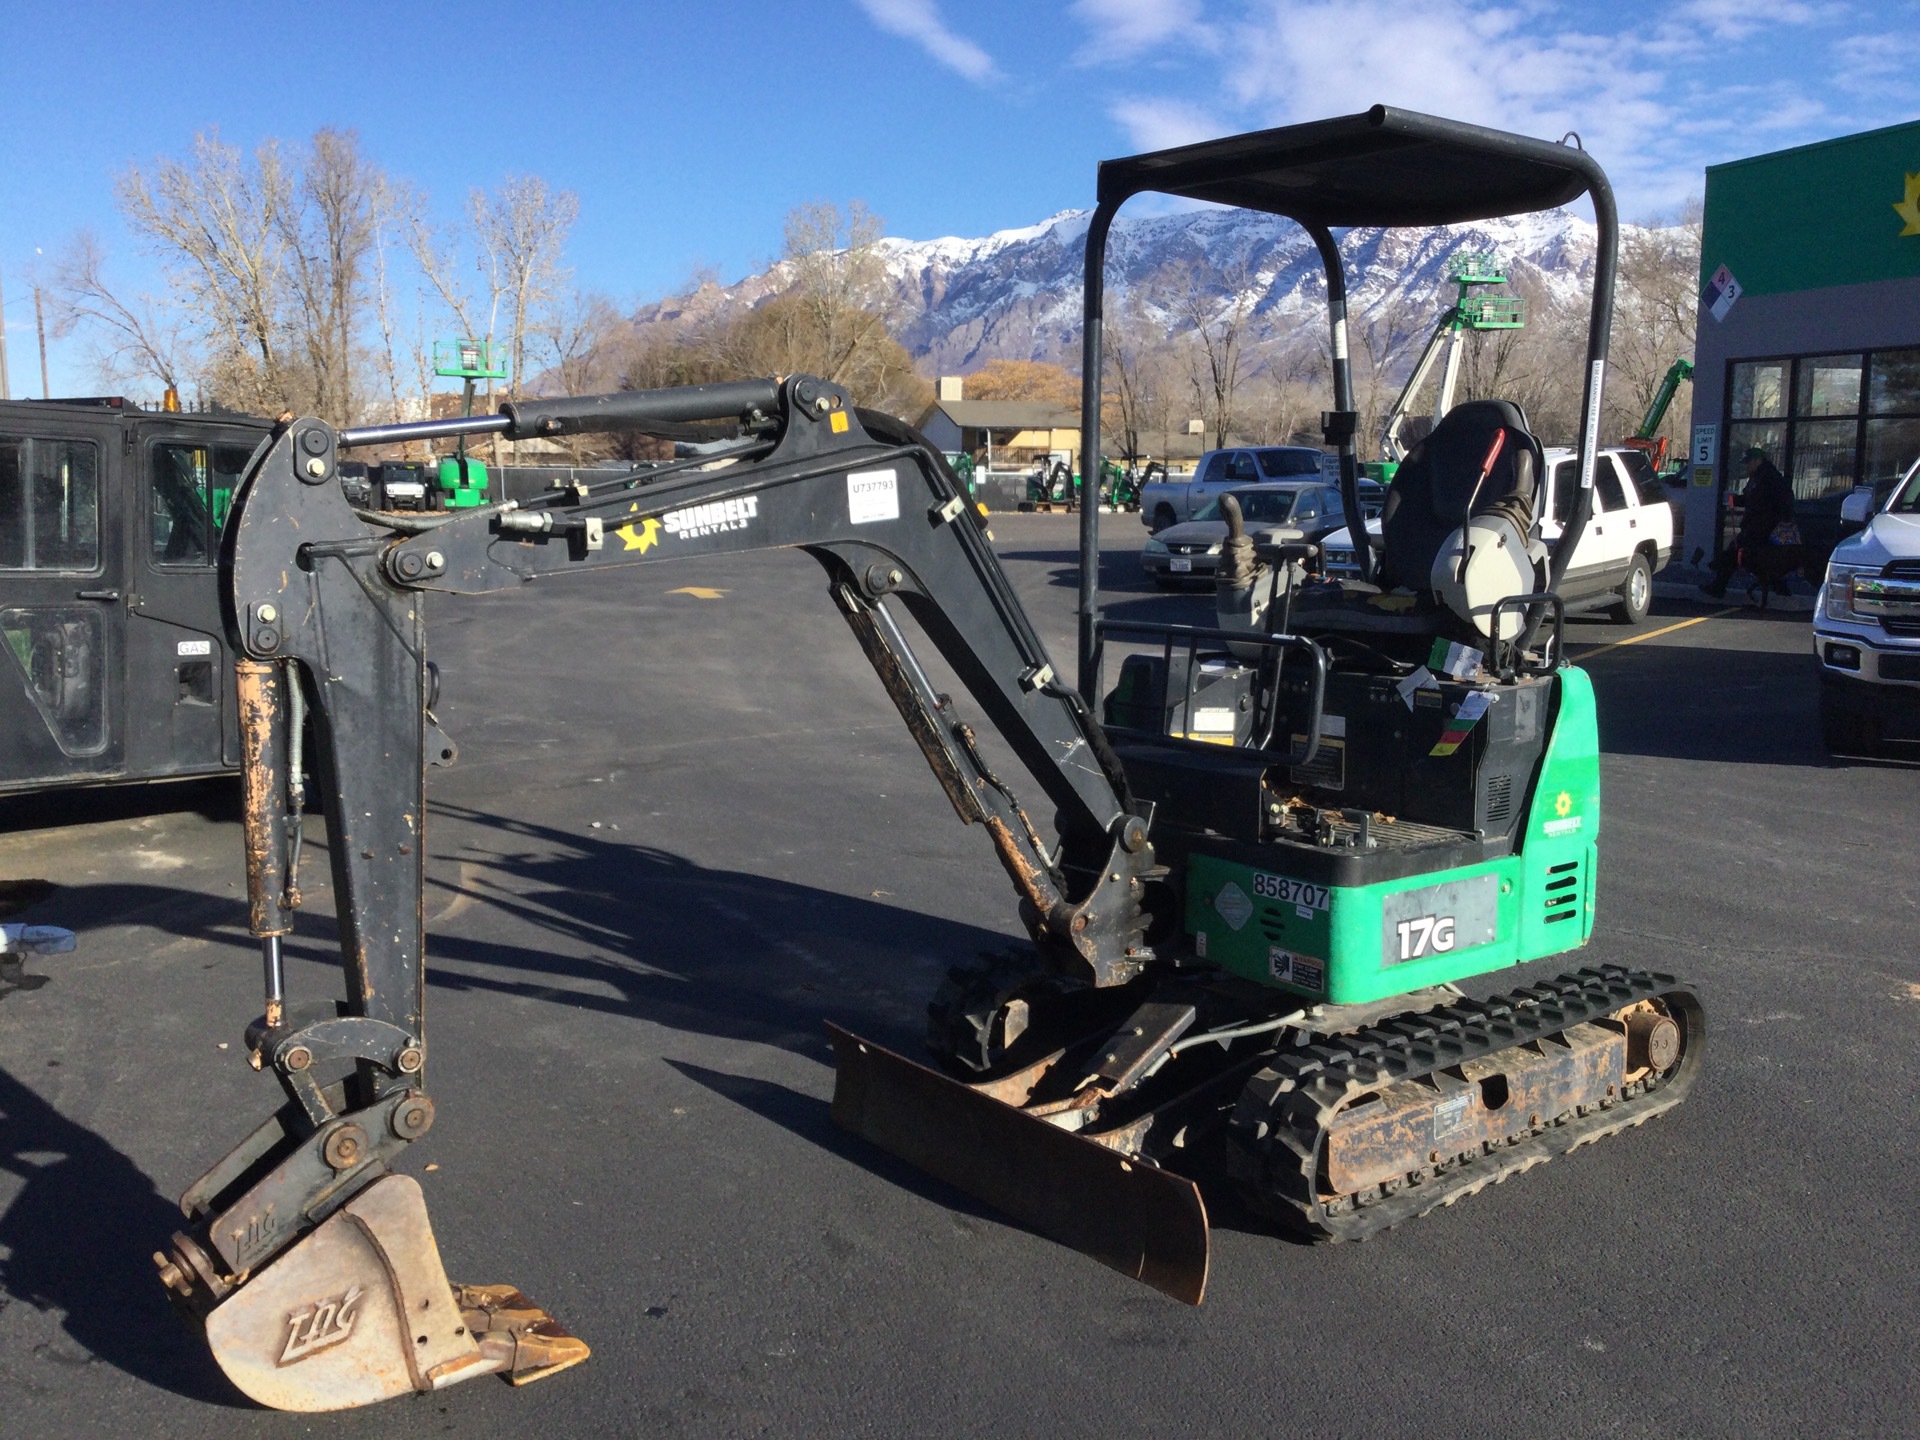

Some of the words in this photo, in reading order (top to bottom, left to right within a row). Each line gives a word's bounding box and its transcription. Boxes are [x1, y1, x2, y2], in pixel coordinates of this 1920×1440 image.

[1718, 272, 1726, 285] 4
[1728, 285, 1735, 299] 3
[1695, 427, 1715, 435] SPEED
[1700, 446, 1708, 461] 5
[852, 480, 894, 494] U737793
[663, 496, 758, 533] SUNBELT
[679, 519, 748, 540] RENTALS
[179, 642, 208, 654] GAS
[1543, 816, 1582, 834] SUNBELT
[1254, 873, 1329, 908] 858707
[1396, 913, 1455, 961] 17G
